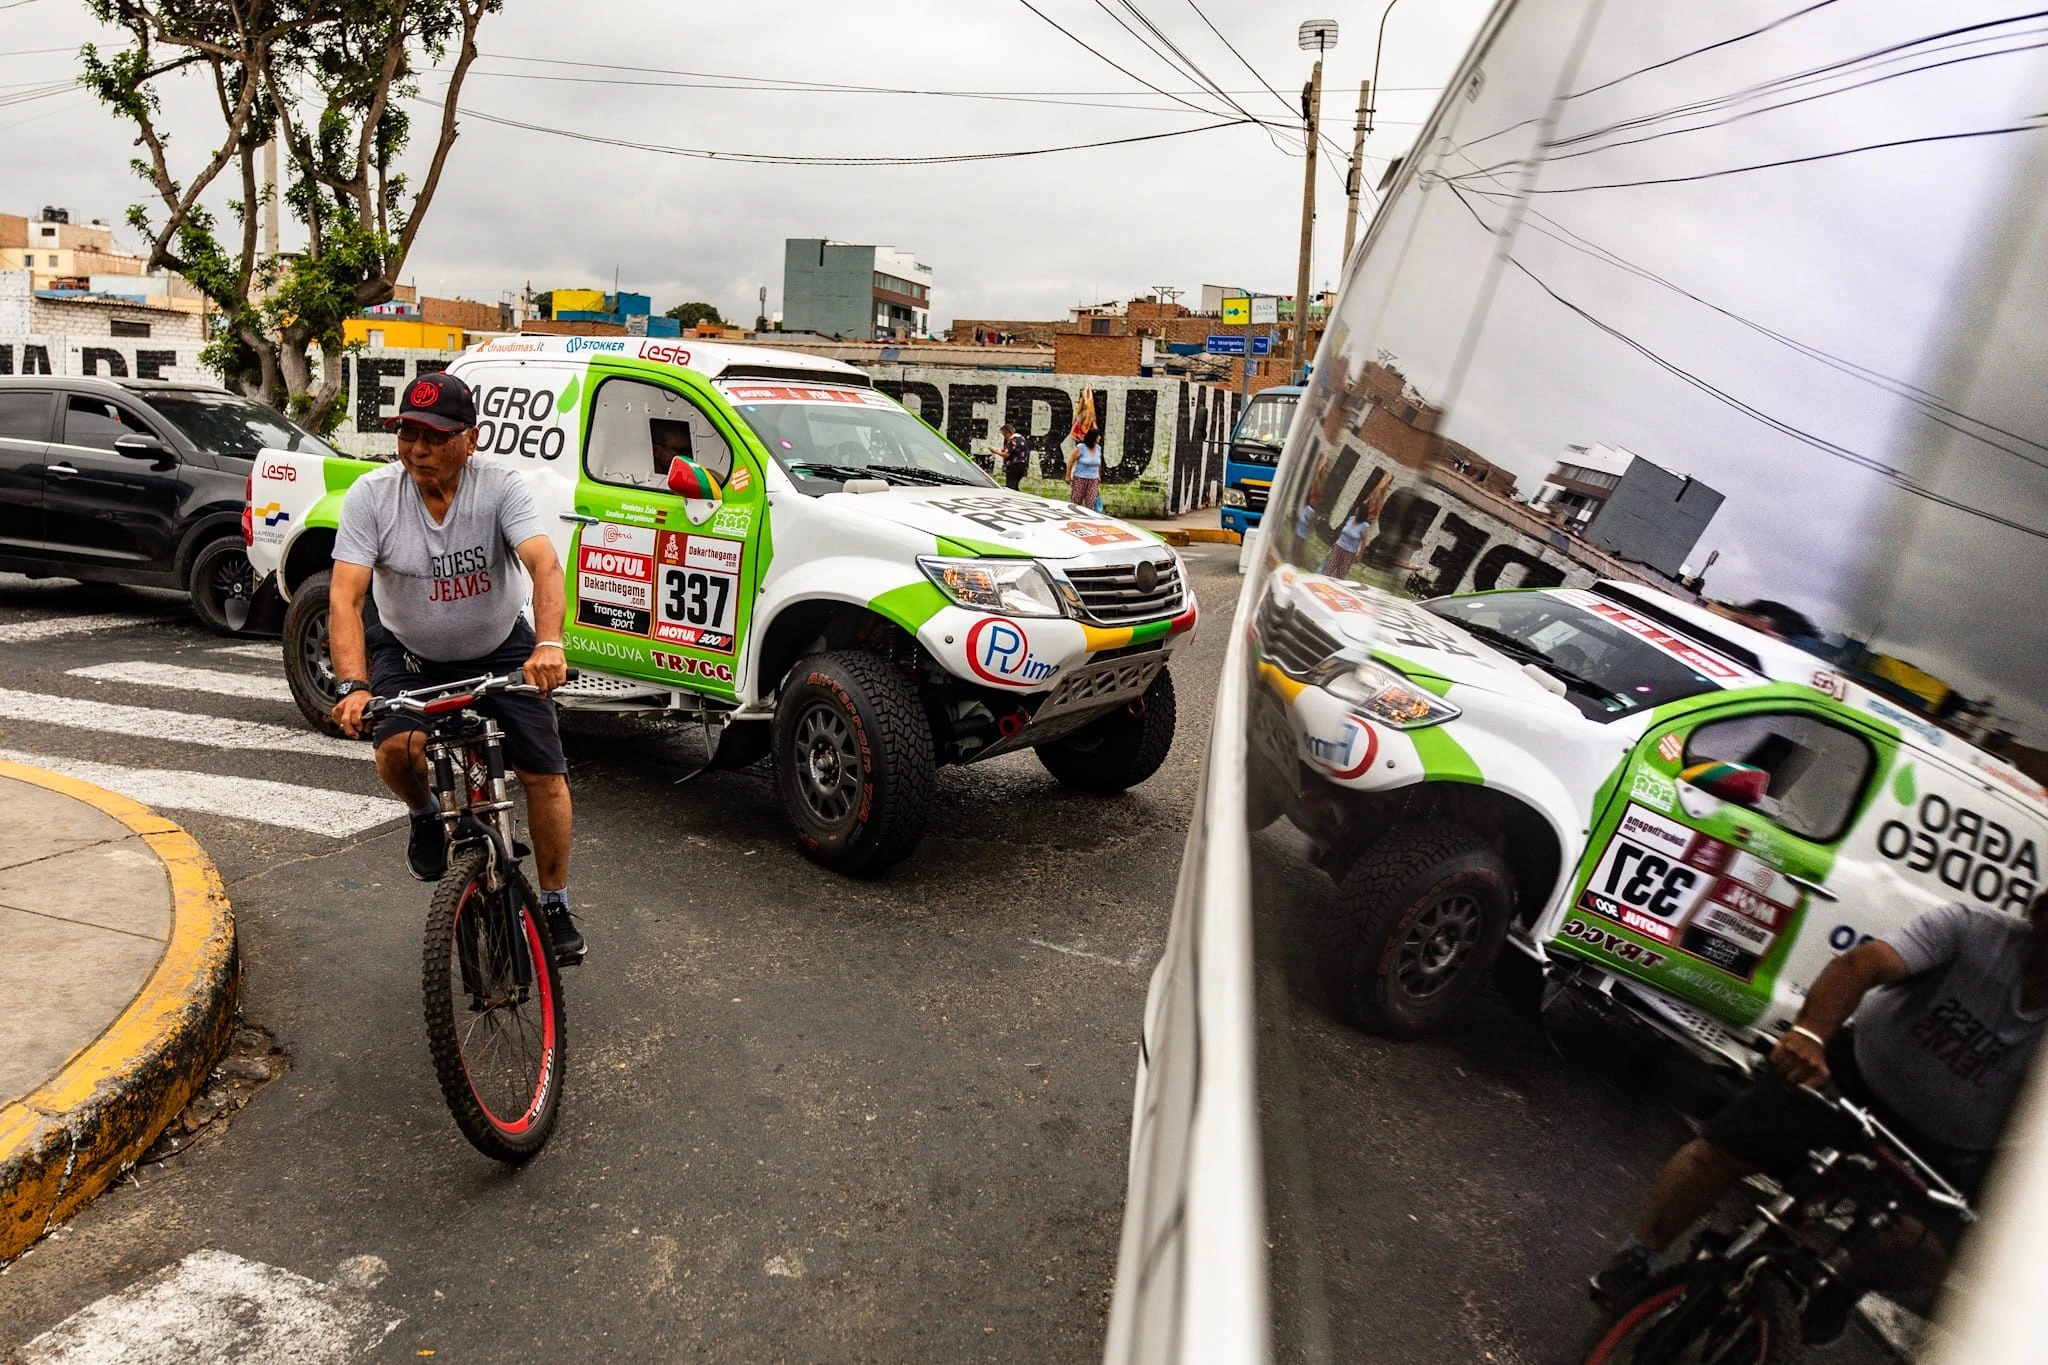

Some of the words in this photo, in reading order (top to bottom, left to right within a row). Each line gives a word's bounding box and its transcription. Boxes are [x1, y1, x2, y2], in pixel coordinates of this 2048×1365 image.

[487, 341, 544, 353] draudimas.lt
[582, 340, 625, 351] STOKKER
[638, 341, 691, 366] Lesta
[476, 420, 565, 461] ODEO
[261, 459, 297, 482] Lesta
[926, 497, 1050, 514] AGRO
[431, 546, 487, 578] GUESS
[585, 551, 646, 577] MOTUL
[688, 545, 738, 562] Dakarthegame
[429, 571, 492, 602] JEANS
[584, 576, 646, 598] Dakarthegame
[630, 596, 646, 607] .com
[665, 569, 730, 629] 337
[610, 617, 635, 630] sport
[658, 625, 697, 643] MOTUL
[698, 632, 734, 648] 300V
[573, 636, 645, 664] SKAUDUVA
[651, 650, 734, 682] TRYGG
